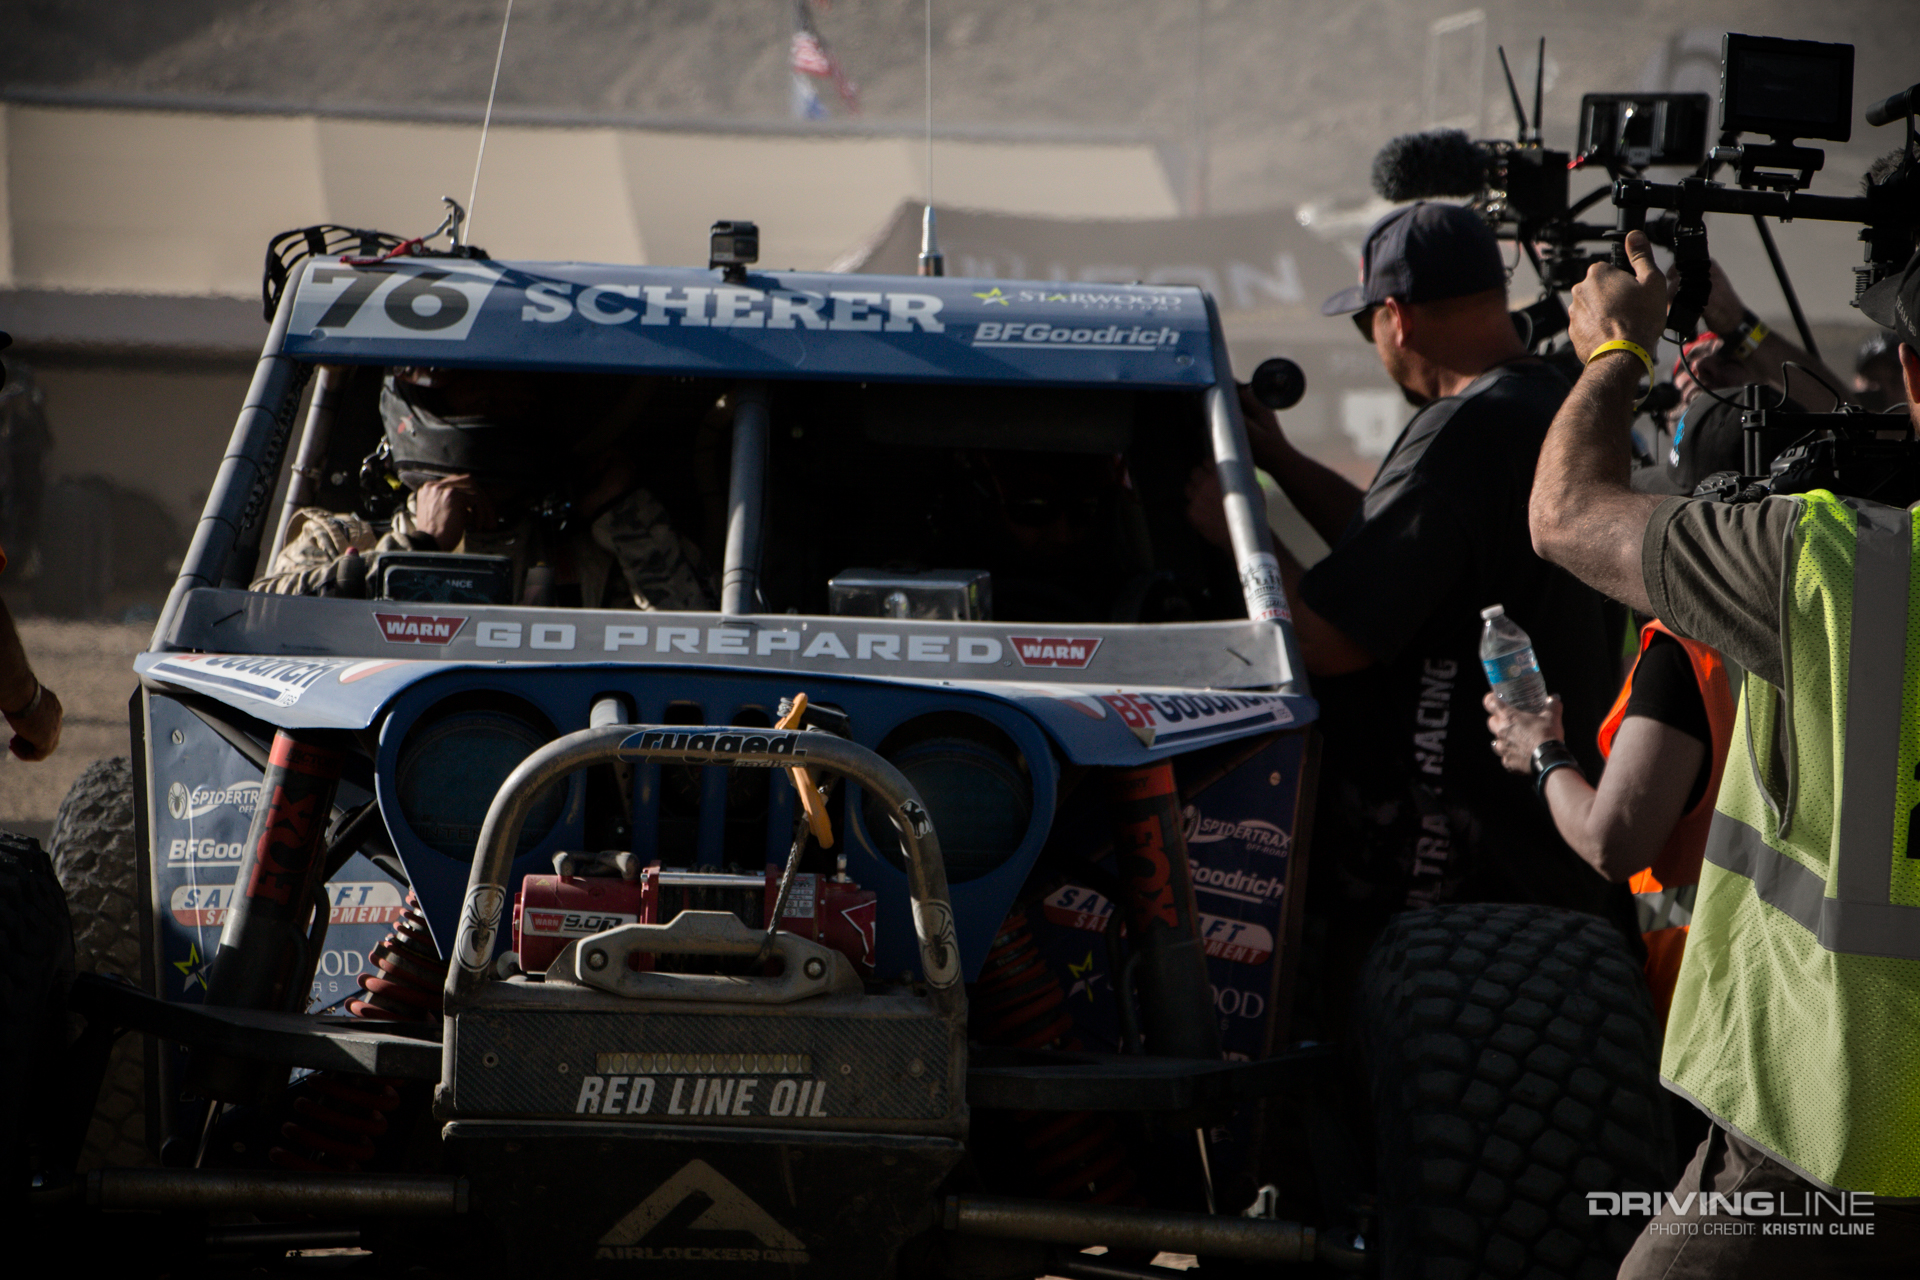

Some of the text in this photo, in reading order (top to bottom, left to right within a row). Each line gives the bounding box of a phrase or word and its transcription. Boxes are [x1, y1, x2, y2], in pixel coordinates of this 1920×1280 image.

[312, 268, 468, 331] 76
[522, 283, 946, 333] SCHERER
[1018, 291, 1182, 305] STARWOOD
[974, 322, 1180, 345] BFGoodrich
[386, 621, 450, 637] WARN
[475, 621, 1003, 664] GO PREPARED
[1021, 643, 1085, 660] WARN
[191, 790, 260, 805] SPIDERTR
[246, 785, 319, 906] FOX
[1199, 818, 1292, 849] SPIDERTRAX
[1246, 844, 1288, 858] OFF-ROAD
[1116, 814, 1180, 934] FOX
[534, 917, 559, 927] WARN
[575, 1076, 827, 1118] RED LINE OIL
